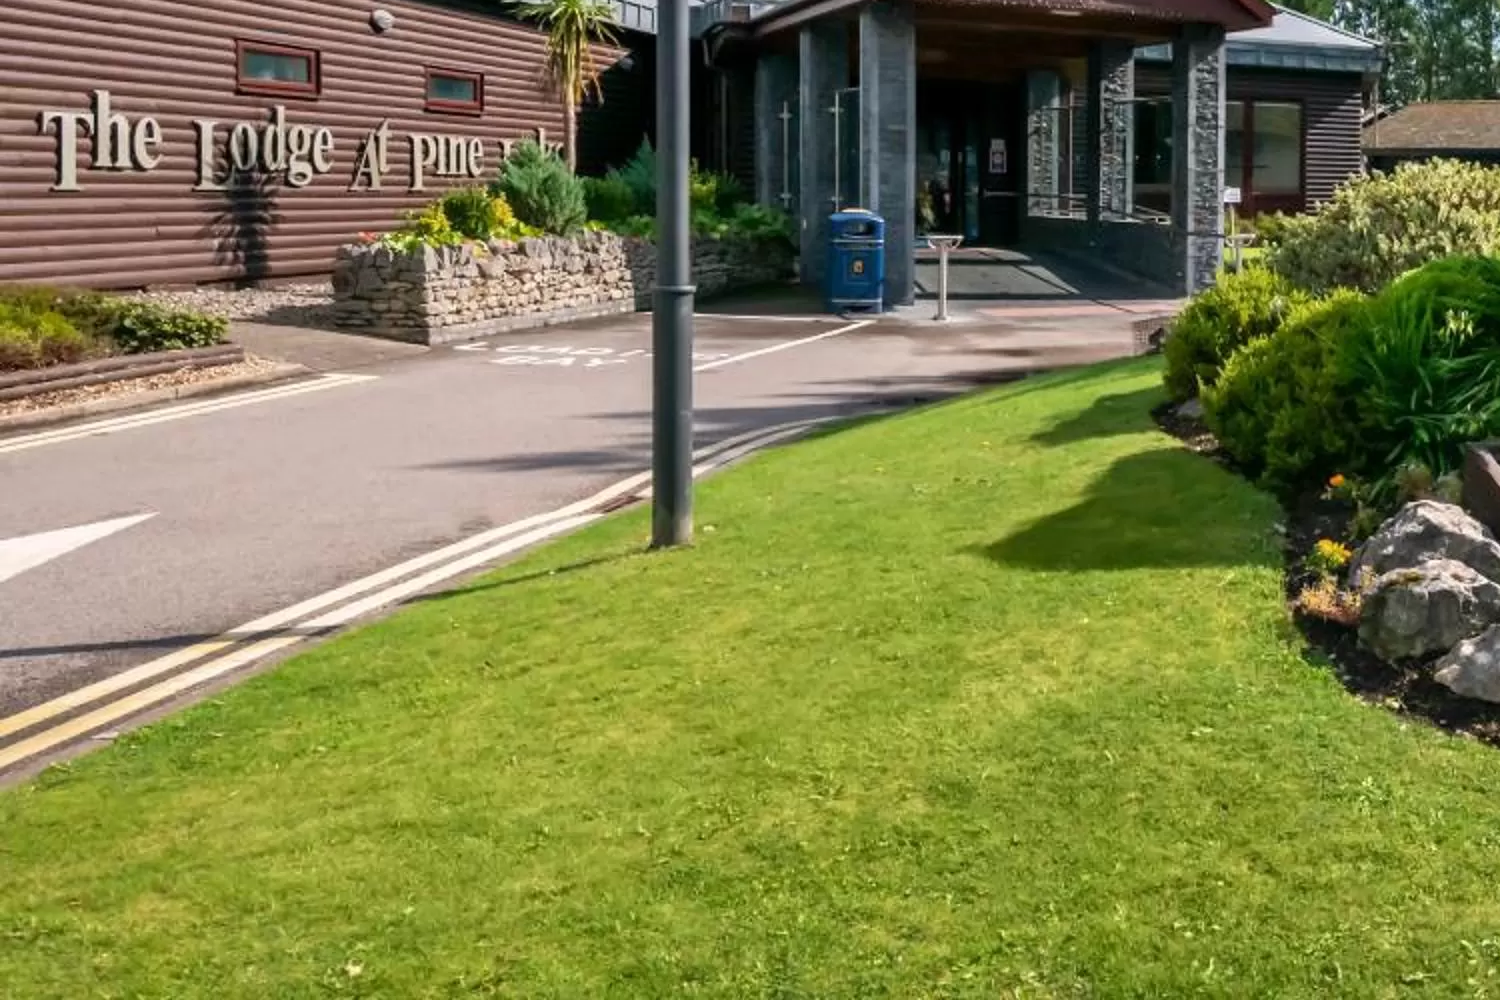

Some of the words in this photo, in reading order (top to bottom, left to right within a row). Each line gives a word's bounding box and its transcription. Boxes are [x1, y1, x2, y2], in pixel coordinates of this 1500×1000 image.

[40, 89, 164, 192] The
[192, 105, 335, 192] Lodge
[350, 118, 393, 192] At
